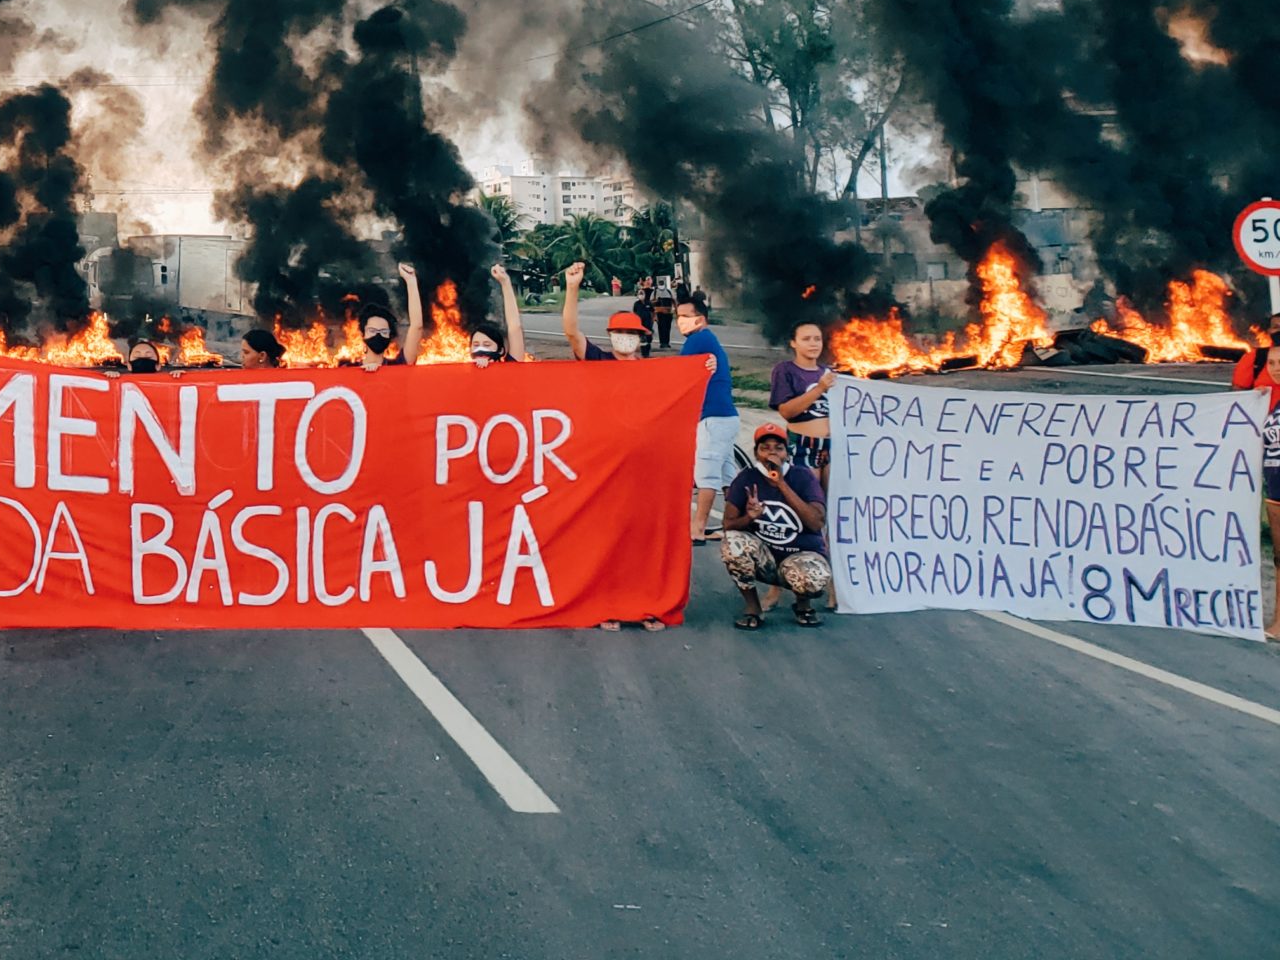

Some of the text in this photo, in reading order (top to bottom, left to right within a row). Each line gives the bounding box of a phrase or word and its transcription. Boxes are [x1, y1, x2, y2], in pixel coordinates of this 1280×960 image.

[842, 385, 1261, 439] PARA ENFRENTAR A
[435, 409, 577, 485] POR
[845, 434, 1256, 492] FOME E A POBREZA
[130, 488, 407, 607] BÁSICA
[424, 485, 555, 607] JÁ
[836, 494, 972, 544] EMPREGO,
[846, 554, 860, 586] E
